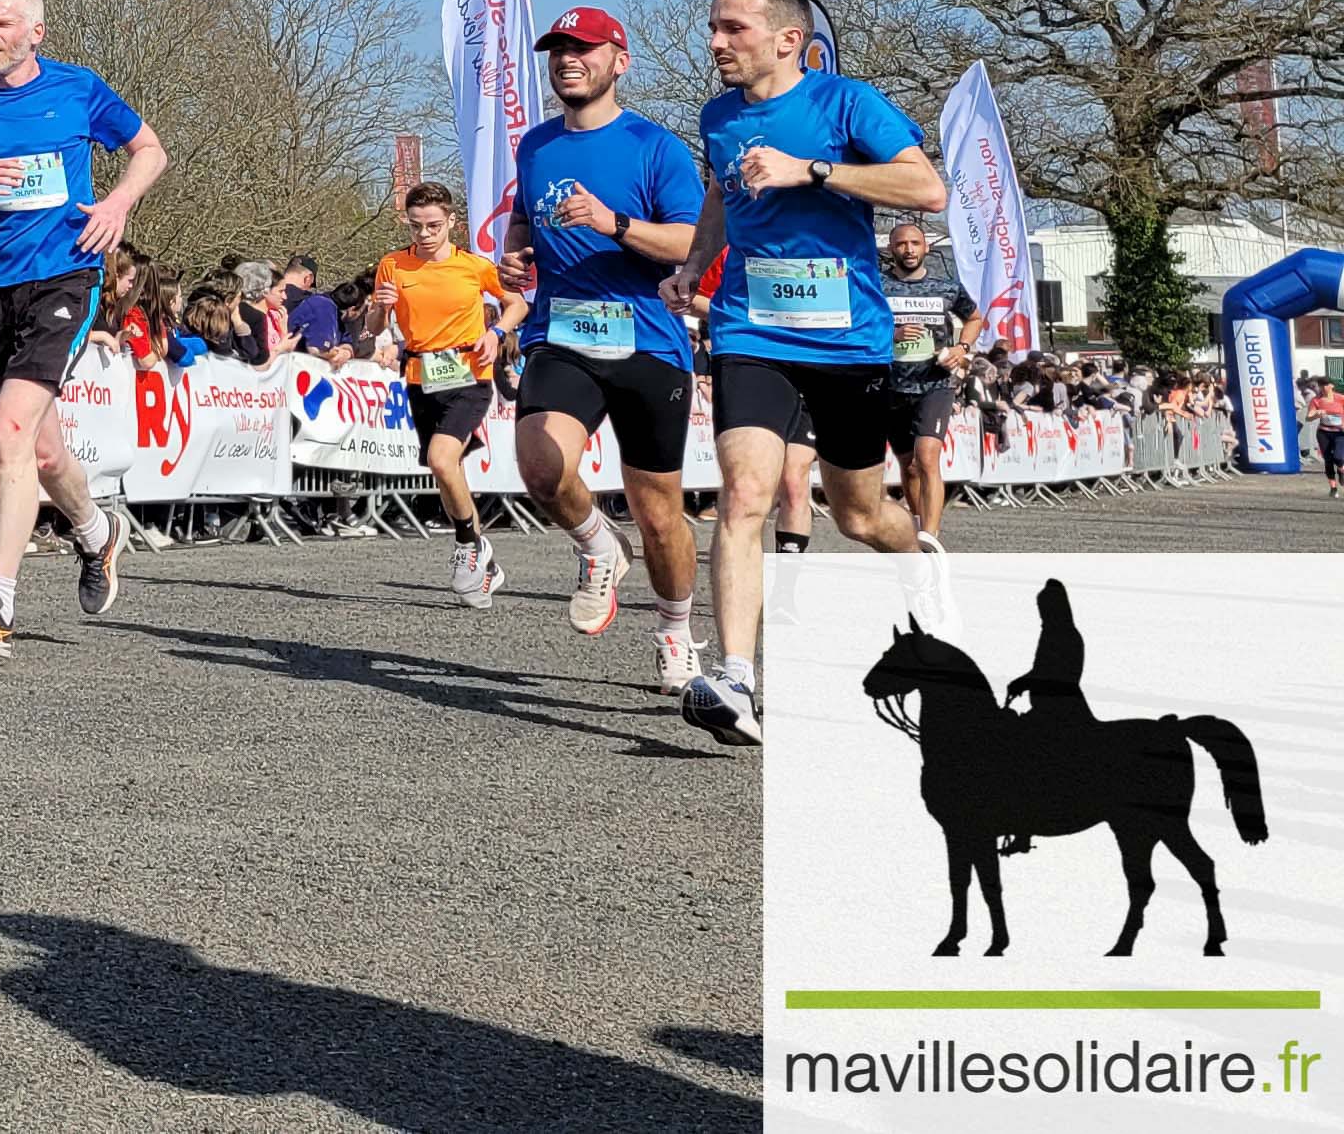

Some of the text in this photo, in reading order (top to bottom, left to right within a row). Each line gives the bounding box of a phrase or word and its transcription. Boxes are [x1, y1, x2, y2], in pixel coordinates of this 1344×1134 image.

[772, 283, 818, 299] 3944
[573, 320, 609, 336] 3944
[1243, 332, 1273, 437] INTERSPORT
[135, 370, 191, 477] Ry
[340, 438, 356, 452] LA
[388, 444, 405, 459] SUR
